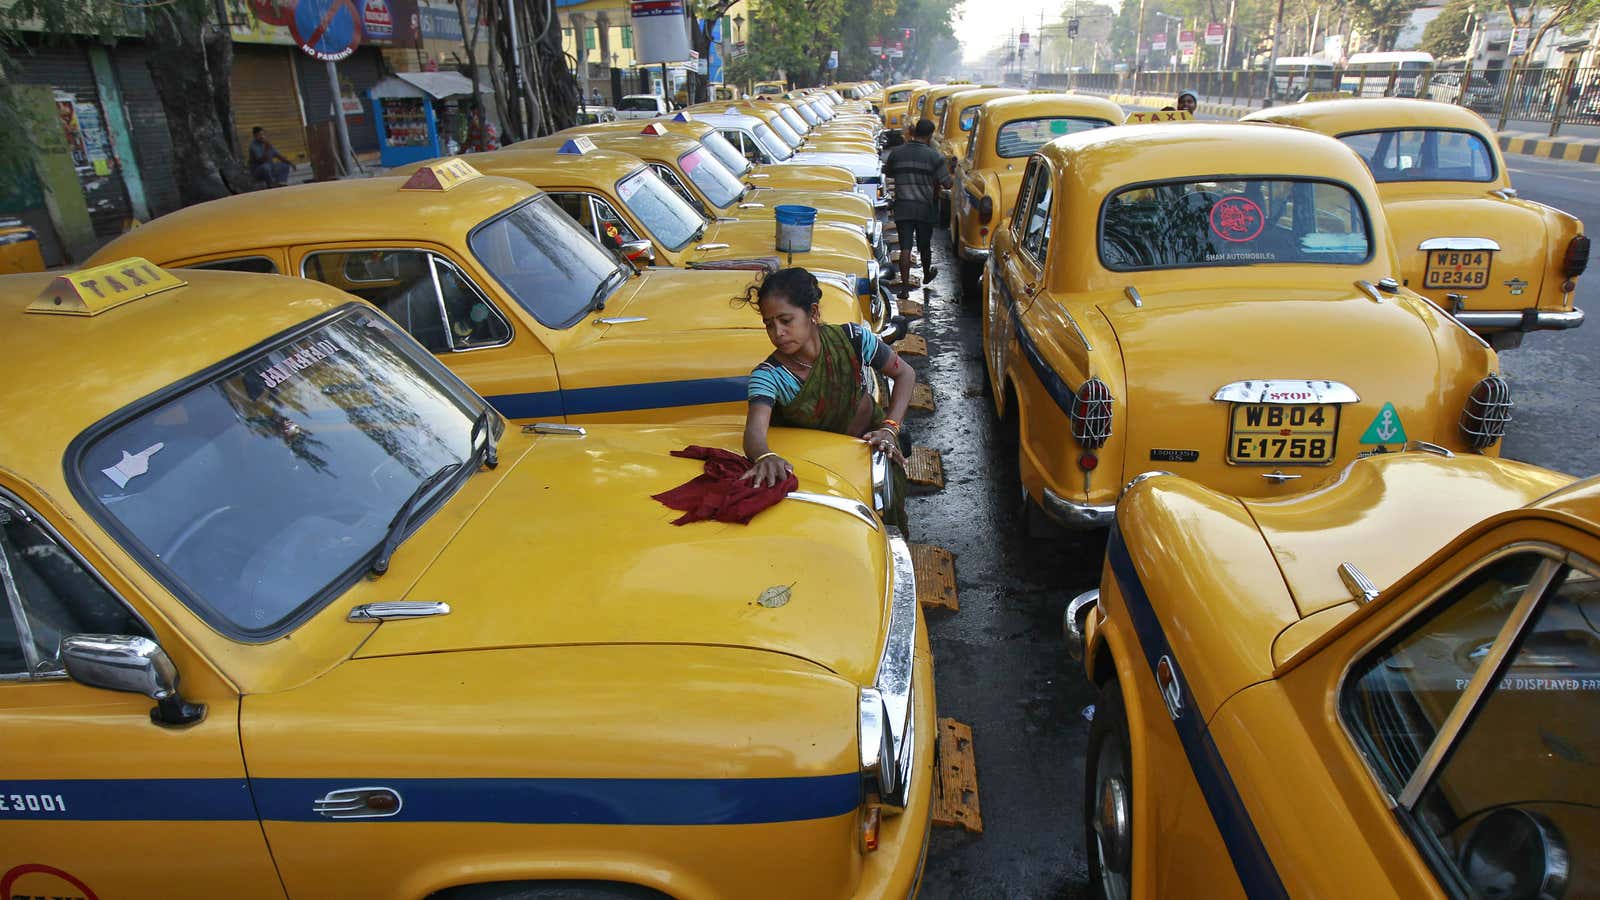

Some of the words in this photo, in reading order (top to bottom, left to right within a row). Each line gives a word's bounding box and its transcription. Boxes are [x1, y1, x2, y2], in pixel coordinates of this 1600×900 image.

[302, 43, 316, 56] NO
[317, 47, 353, 61] PARKING
[1134, 111, 1186, 122] TAXI
[1226, 252, 1275, 260] AUTOMOBILES
[80, 264, 160, 298] TAXI
[259, 363, 291, 388] JAI
[282, 346, 327, 374] MATA
[1270, 392, 1311, 401] STOP
[1516, 678, 1579, 690] DISPLAYED
